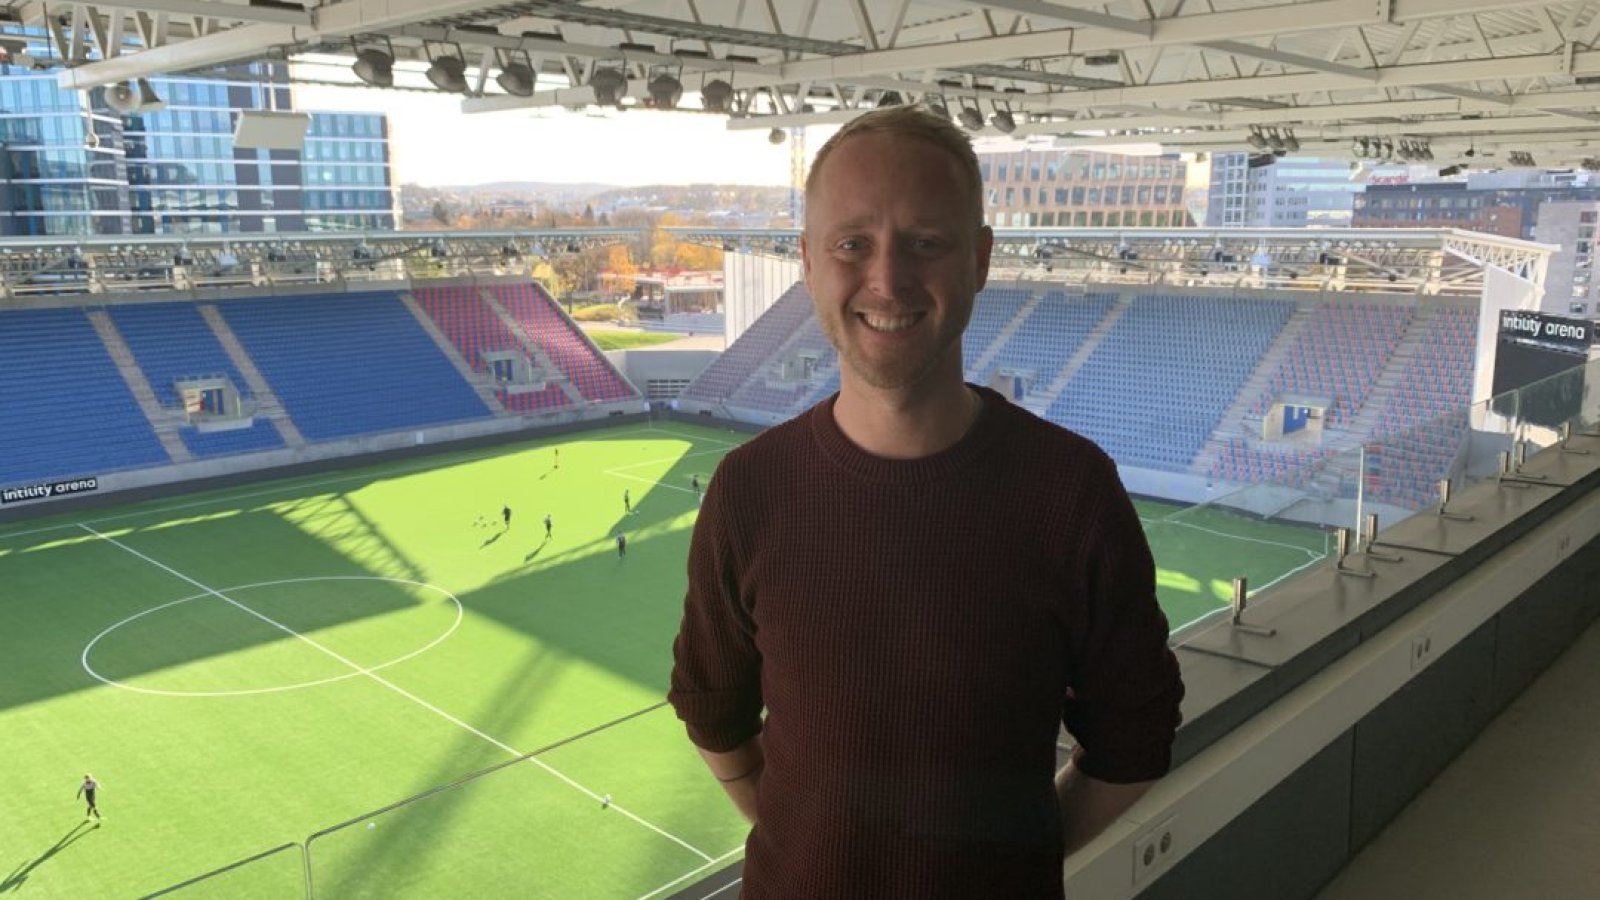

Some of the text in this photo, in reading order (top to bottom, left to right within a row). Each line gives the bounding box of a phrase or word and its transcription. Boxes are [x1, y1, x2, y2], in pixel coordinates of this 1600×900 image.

[1545, 322, 1585, 340] arena
[3, 479, 96, 499] intility arena
